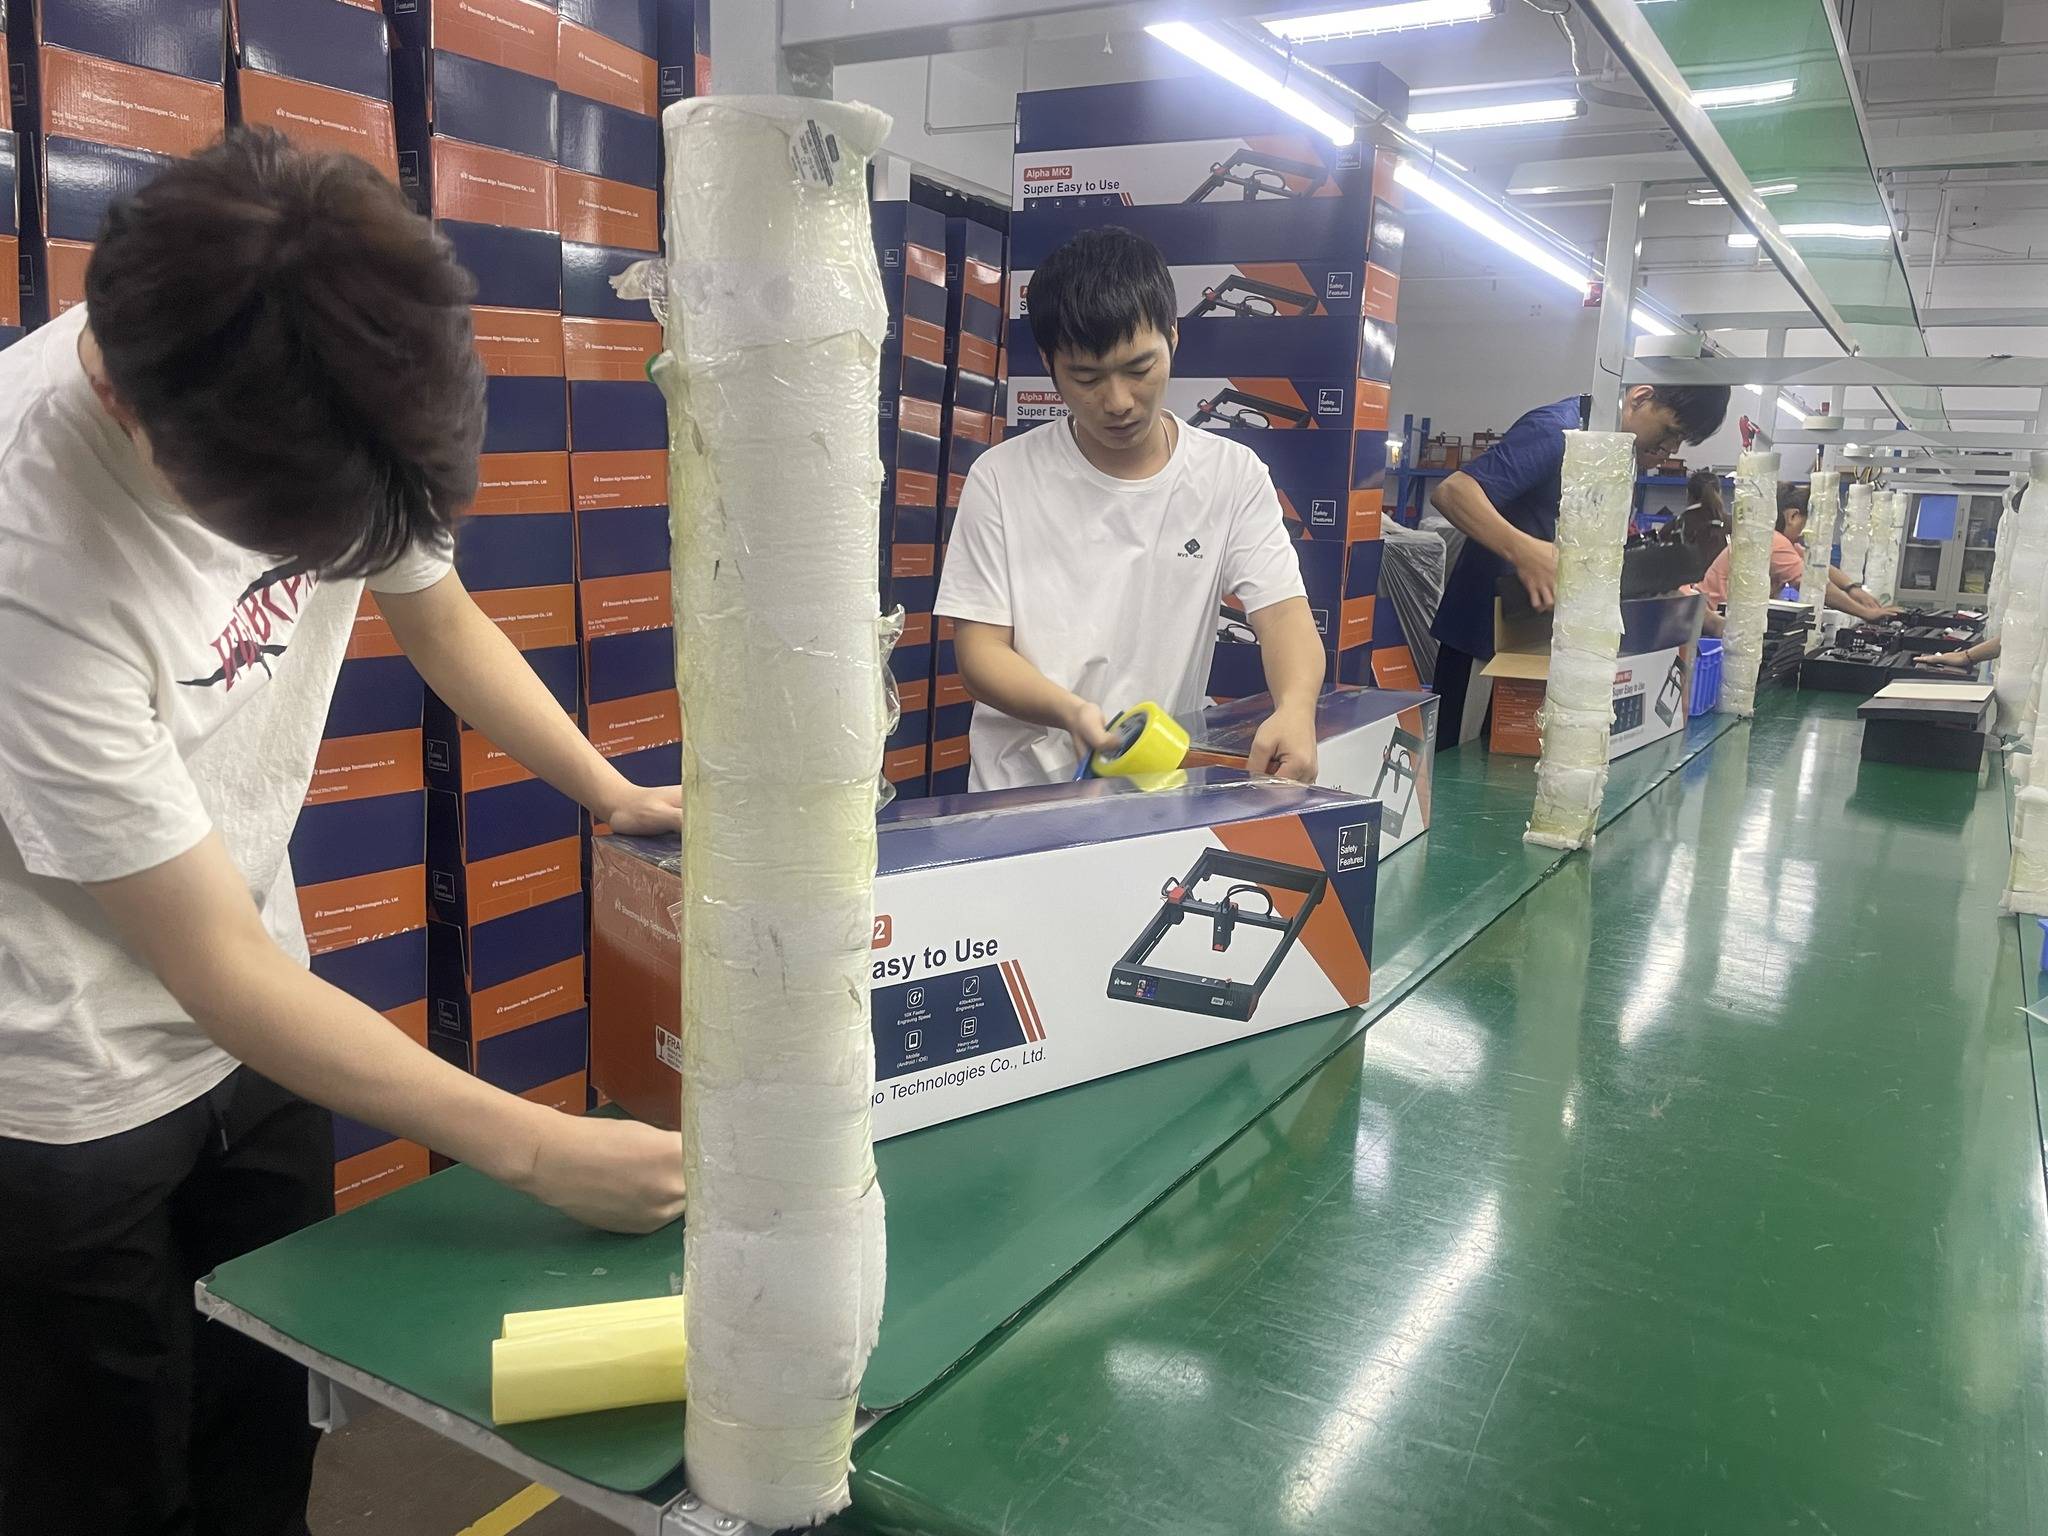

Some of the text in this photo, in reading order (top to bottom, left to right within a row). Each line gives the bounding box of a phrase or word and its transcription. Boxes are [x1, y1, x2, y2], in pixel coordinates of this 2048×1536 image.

[1026, 167, 1070, 180] Alpha MK2
[1024, 180, 1120, 196] Super Easy to Use
[1330, 275, 1336, 283] 7
[1019, 392, 1043, 402] Alpha
[1321, 392, 1327, 400] 7
[1017, 406, 1070, 417] Super Eas
[1315, 503, 1320, 511] 7
[1341, 831, 1348, 845] 7
[1340, 844, 1358, 855] Safety
[1340, 856, 1364, 867] Features
[872, 938, 999, 980] asy to Use
[890, 1065, 986, 1100] Technologies
[990, 1057, 1017, 1074] Co.,
[1022, 1047, 1047, 1065] Ltd.
